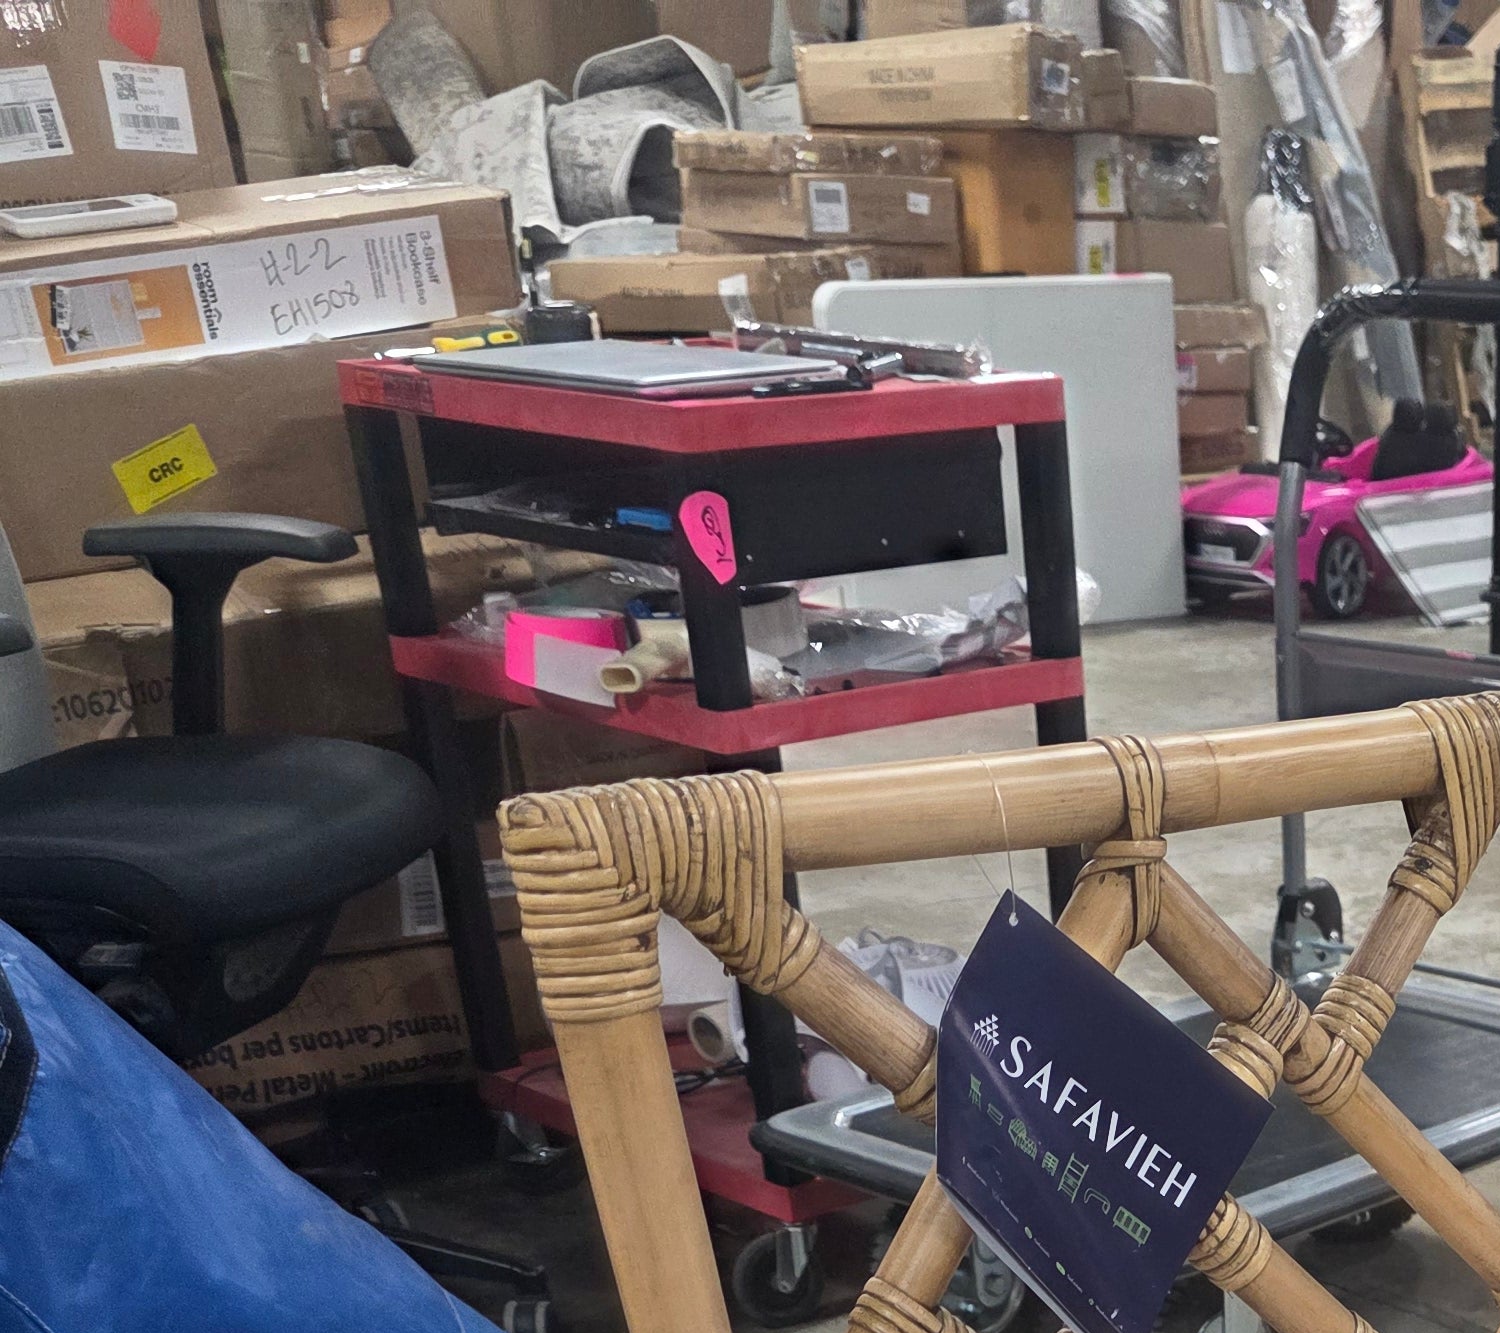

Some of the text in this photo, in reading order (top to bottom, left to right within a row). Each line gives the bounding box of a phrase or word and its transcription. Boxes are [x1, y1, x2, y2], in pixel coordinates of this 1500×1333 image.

[192, 263, 219, 340] essentials
[200, 261, 219, 304] room
[148, 457, 184, 483] CRC
[999, 1035, 1198, 1208] SAFAVIEH
